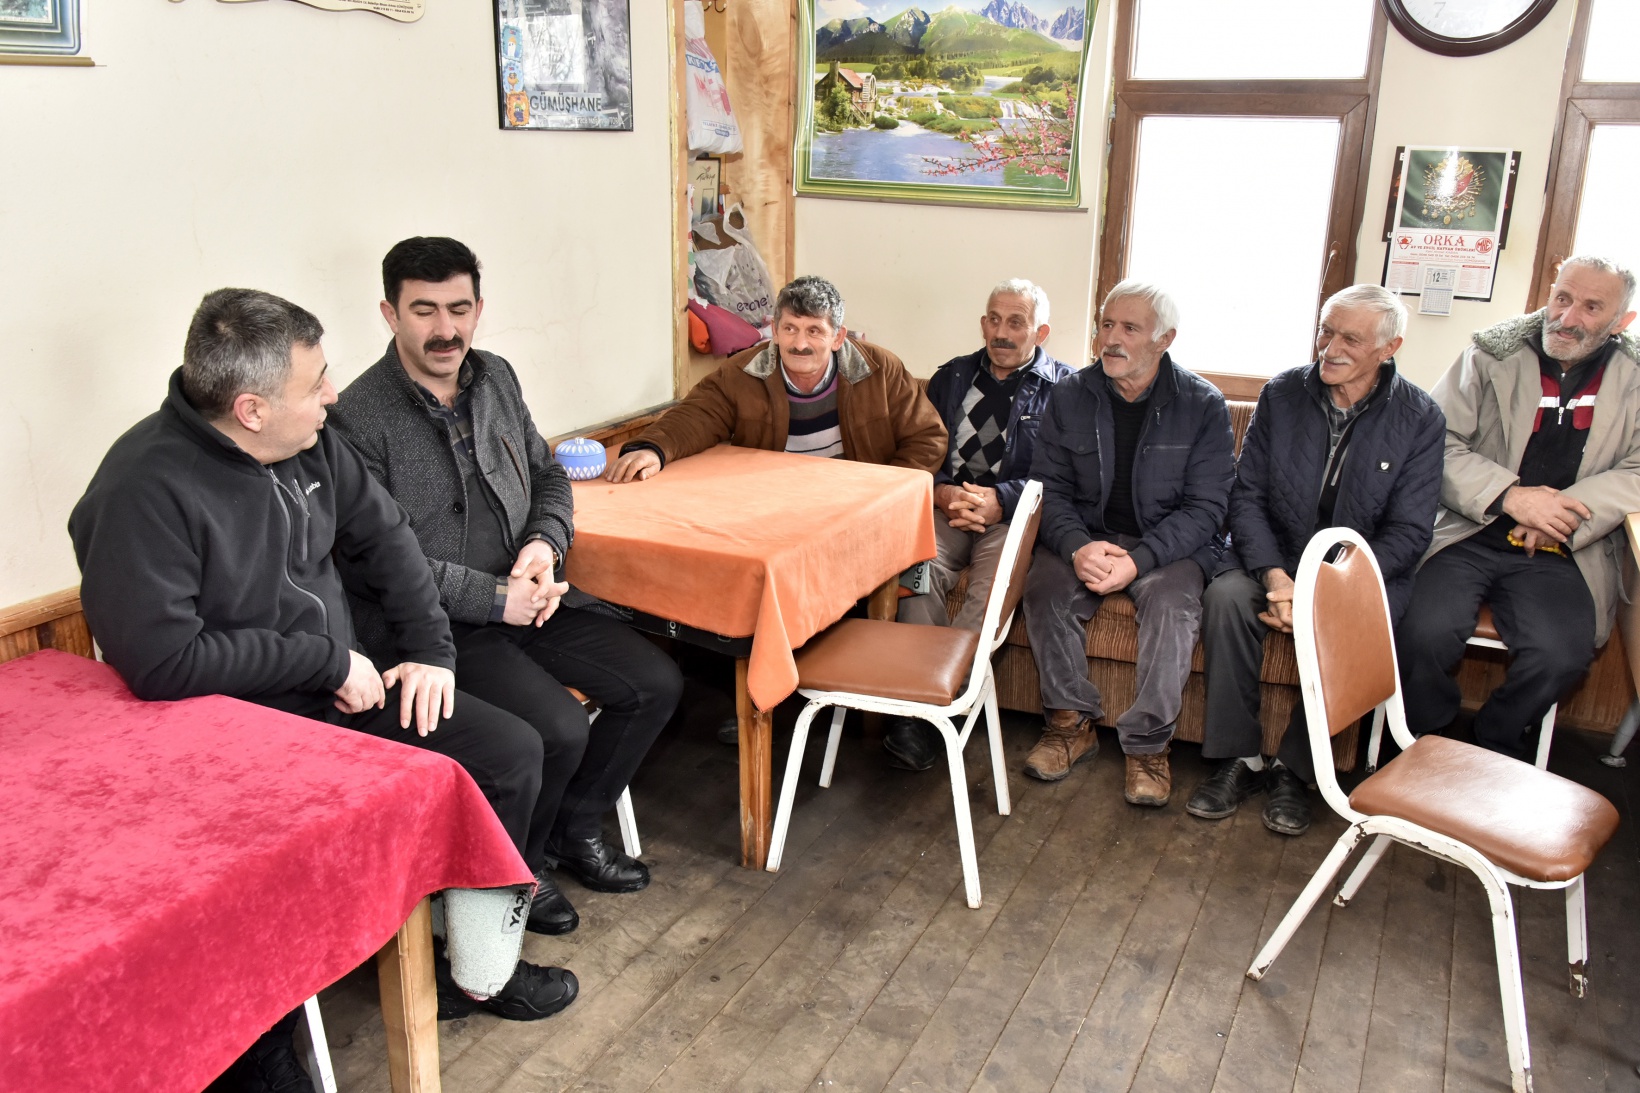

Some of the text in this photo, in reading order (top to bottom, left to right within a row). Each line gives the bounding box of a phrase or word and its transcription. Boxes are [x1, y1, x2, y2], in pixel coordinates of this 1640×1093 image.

[1434, 1, 1447, 18] 7
[529, 92, 602, 113] GÜMÜŞHANE
[1423, 234, 1465, 246] ORKA
[1432, 272, 1441, 283] 12
